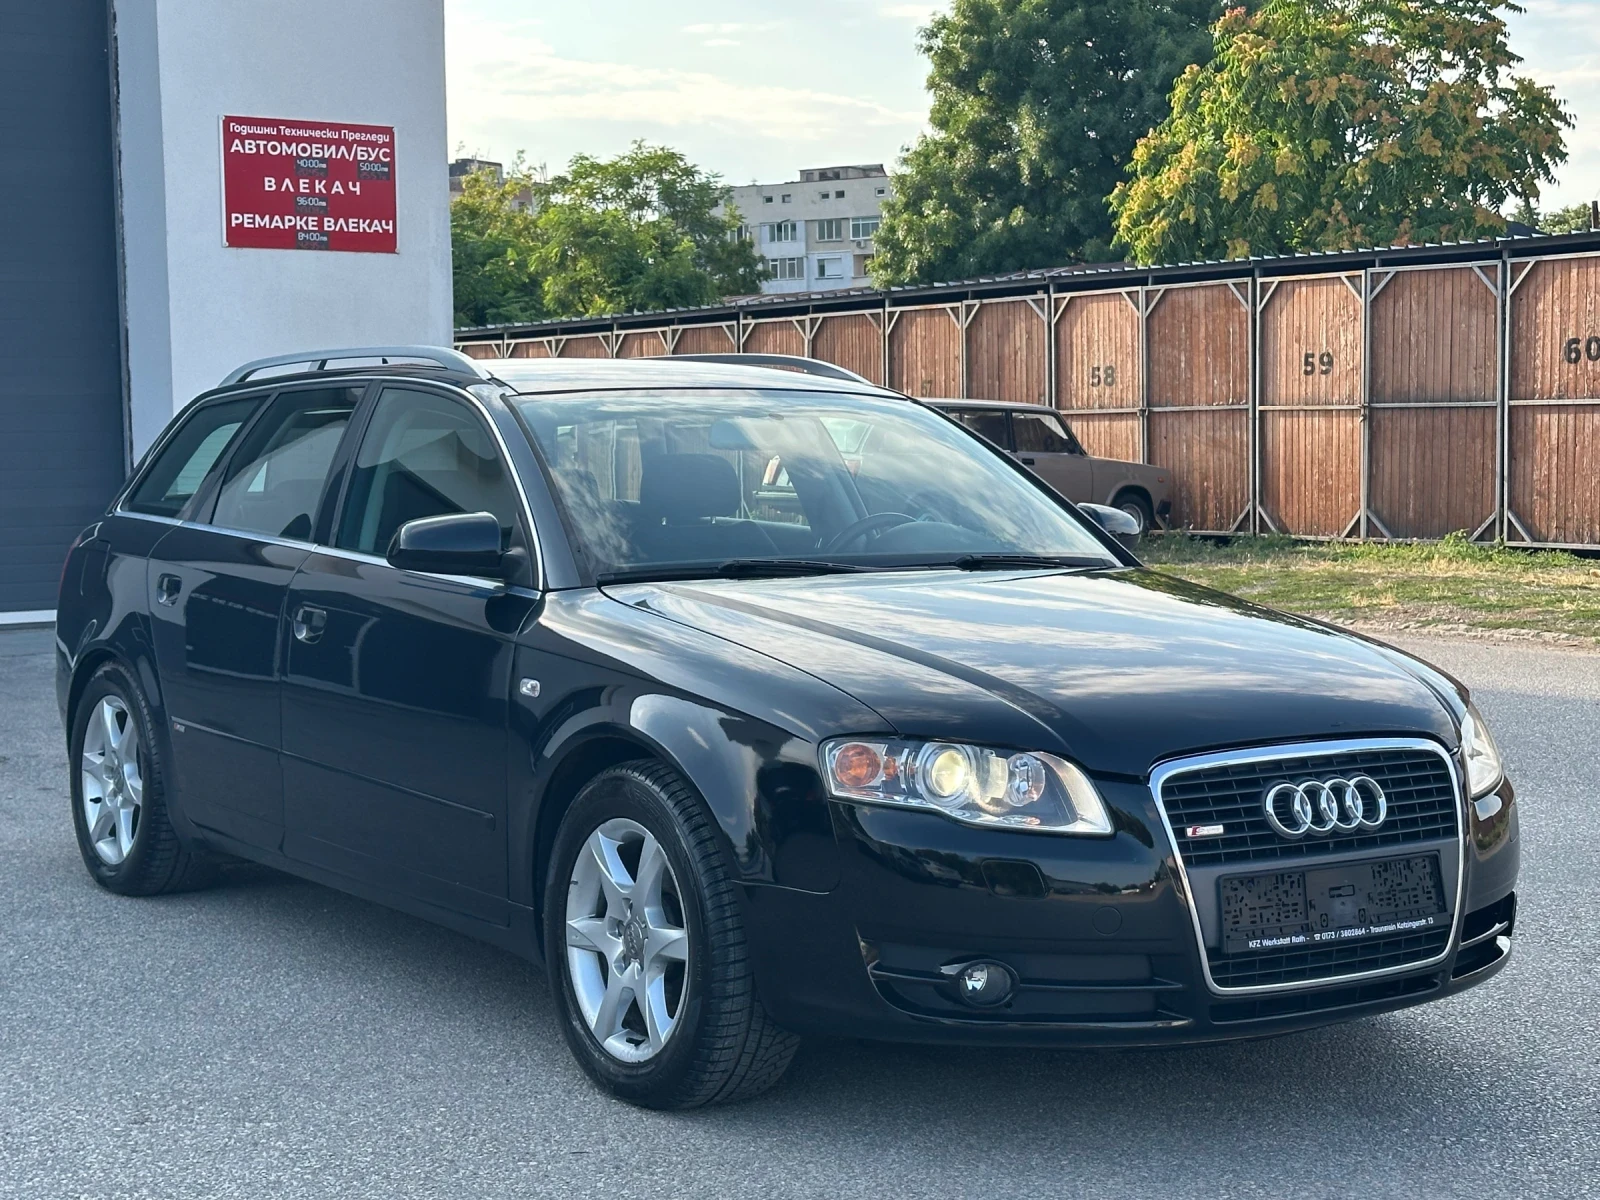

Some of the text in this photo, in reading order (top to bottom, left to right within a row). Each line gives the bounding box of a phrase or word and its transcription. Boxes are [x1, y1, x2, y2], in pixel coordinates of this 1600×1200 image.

[230, 122, 390, 144] Годишни Технически Прегледи
[230, 138, 391, 162] АВТОМОБИЛ/БУС
[264, 177, 361, 195] ВЛЕКАЧ
[231, 213, 393, 233] РЕМАРКЕ ВЛЕКАЧ
[1564, 335, 1600, 364] 60
[1303, 351, 1334, 376] 59
[1091, 365, 1115, 387] 58
[1248, 939, 1261, 948] KFZ
[1262, 936, 1291, 947] Werkstatt
[1321, 931, 1335, 940] 0173
[1427, 916, 1434, 924] 13
